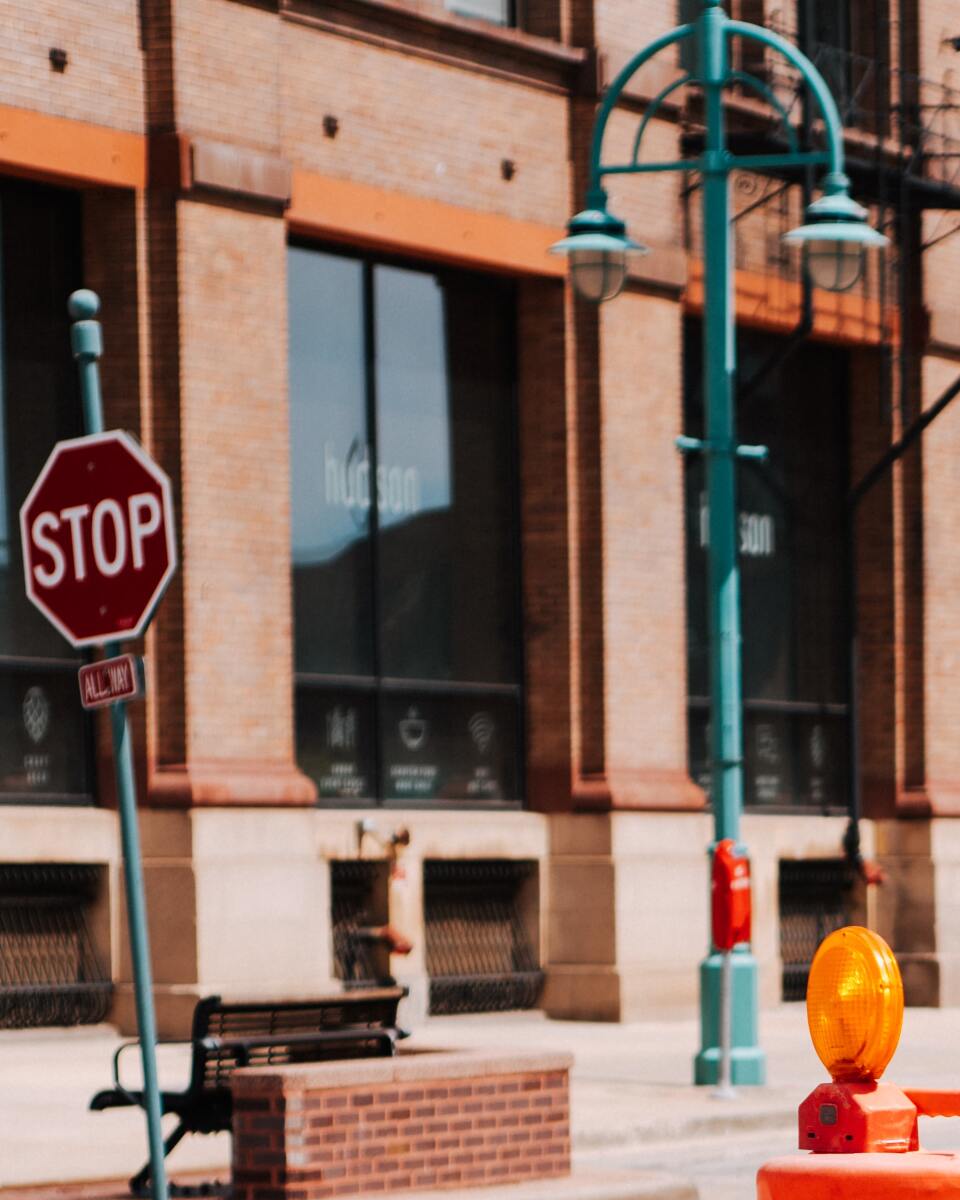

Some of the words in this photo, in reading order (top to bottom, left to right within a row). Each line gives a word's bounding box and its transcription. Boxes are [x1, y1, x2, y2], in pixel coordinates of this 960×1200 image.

[31, 492, 162, 588] STOP
[85, 671, 108, 701] ALL
[107, 663, 128, 692] WAY
